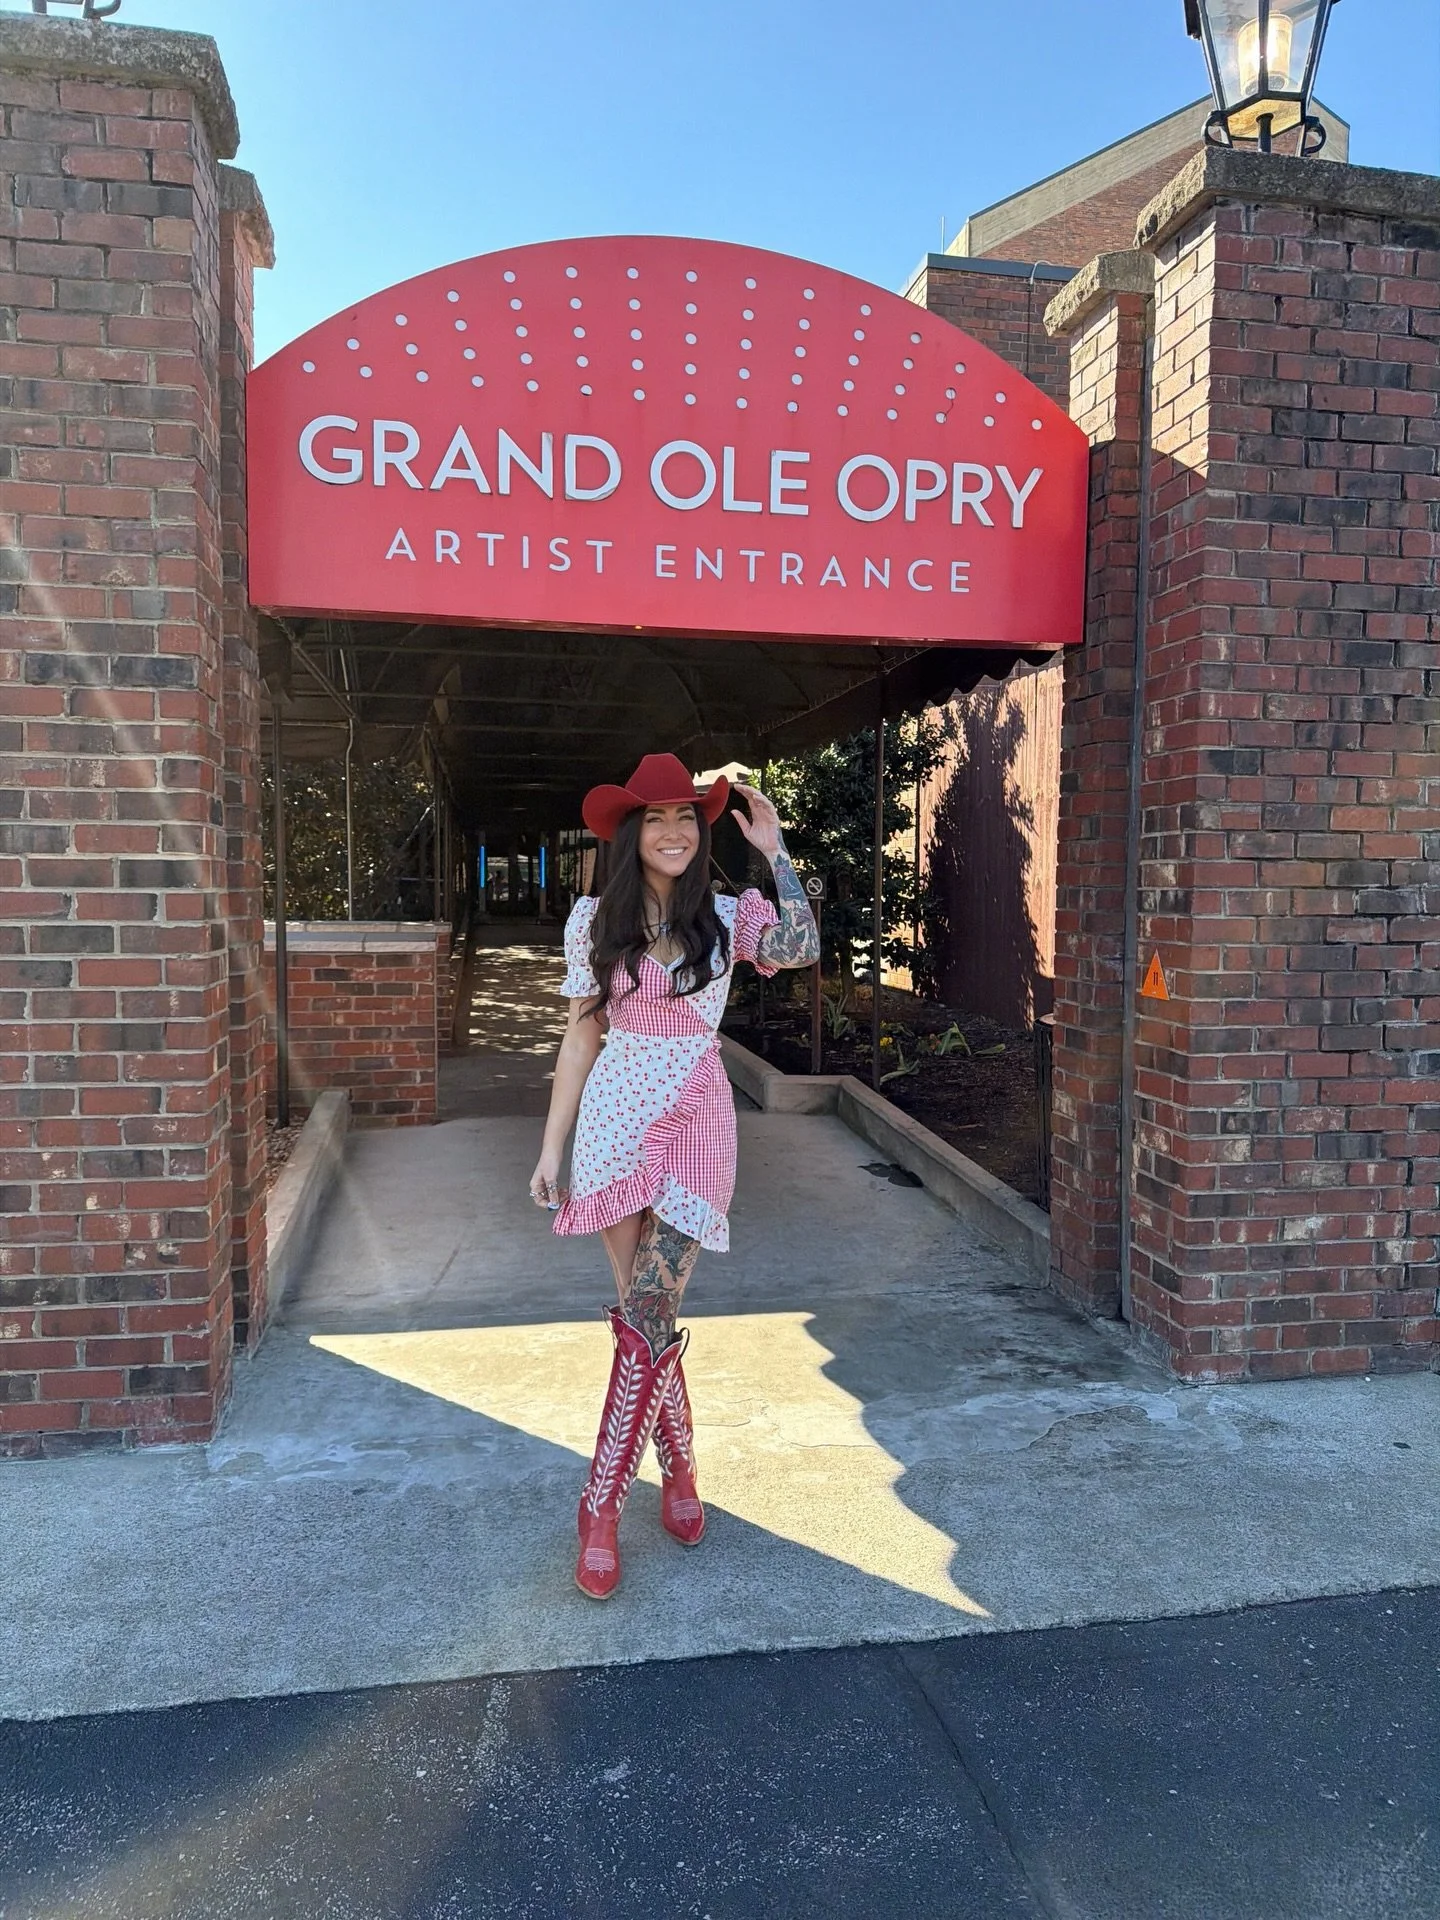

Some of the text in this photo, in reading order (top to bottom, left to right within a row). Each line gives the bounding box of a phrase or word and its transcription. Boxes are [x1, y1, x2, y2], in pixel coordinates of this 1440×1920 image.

[298, 414, 1043, 529] GRAND OLE OPRY
[385, 527, 971, 593] ARTIST ENTRANCE
